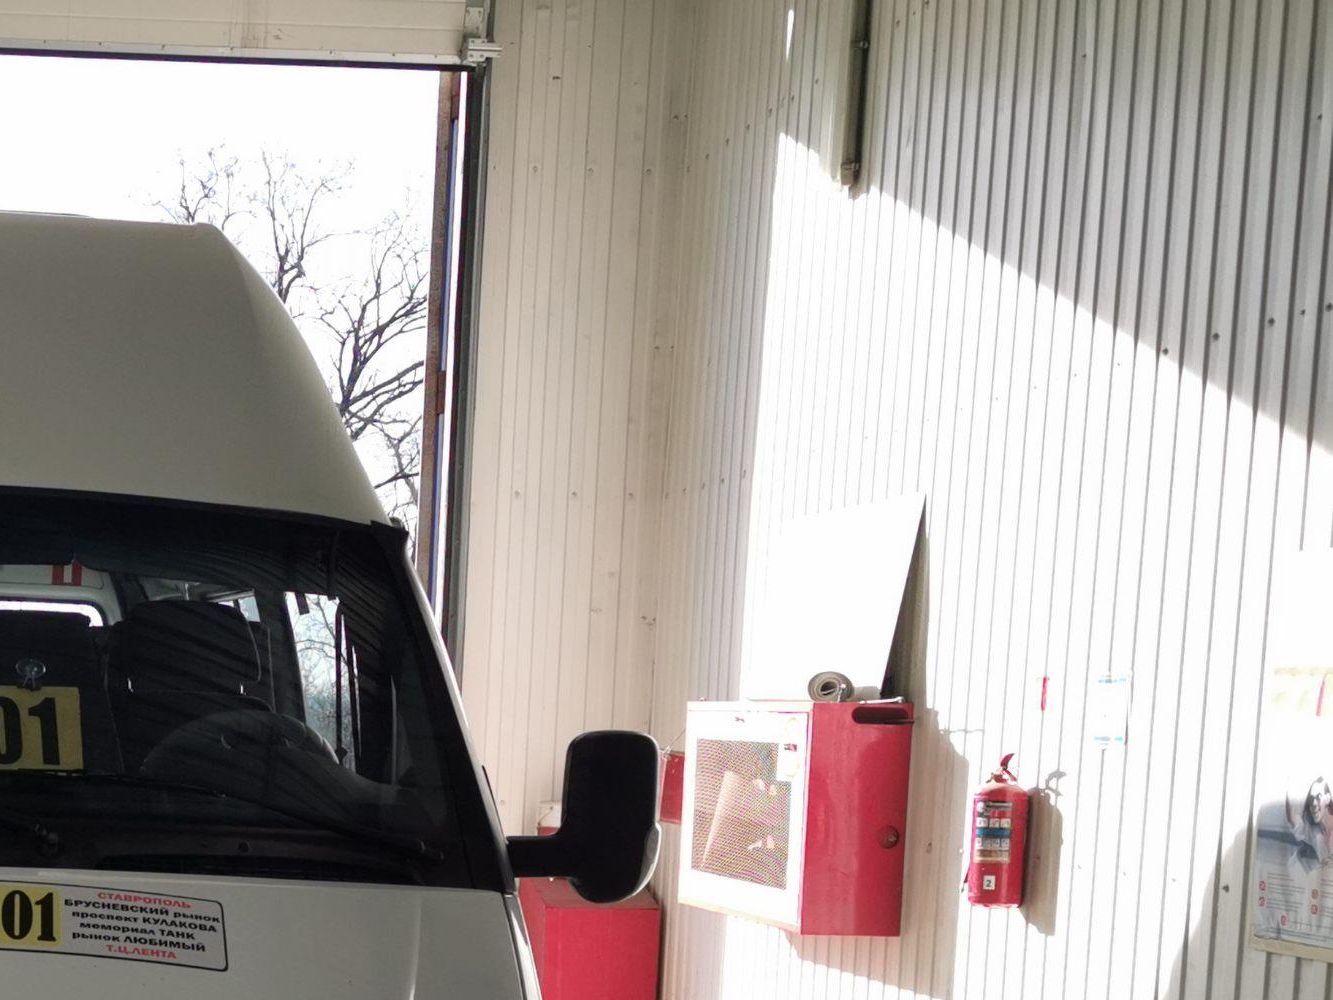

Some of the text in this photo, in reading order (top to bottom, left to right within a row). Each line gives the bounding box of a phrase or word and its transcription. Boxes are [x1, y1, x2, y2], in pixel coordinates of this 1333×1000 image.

[97, 891, 191, 909] СТАВРОПОЛЬ
[64, 898, 221, 924] БРУСНЕВСКИЙ рынок
[72, 911, 217, 933] проспект КУЛАКОВА
[79, 921, 195, 941] мемориал ТАНК
[72, 931, 206, 952] рынок ЛЮБИМЫЙ
[106, 944, 177, 959] Т.Ц.ЛЕНТА
